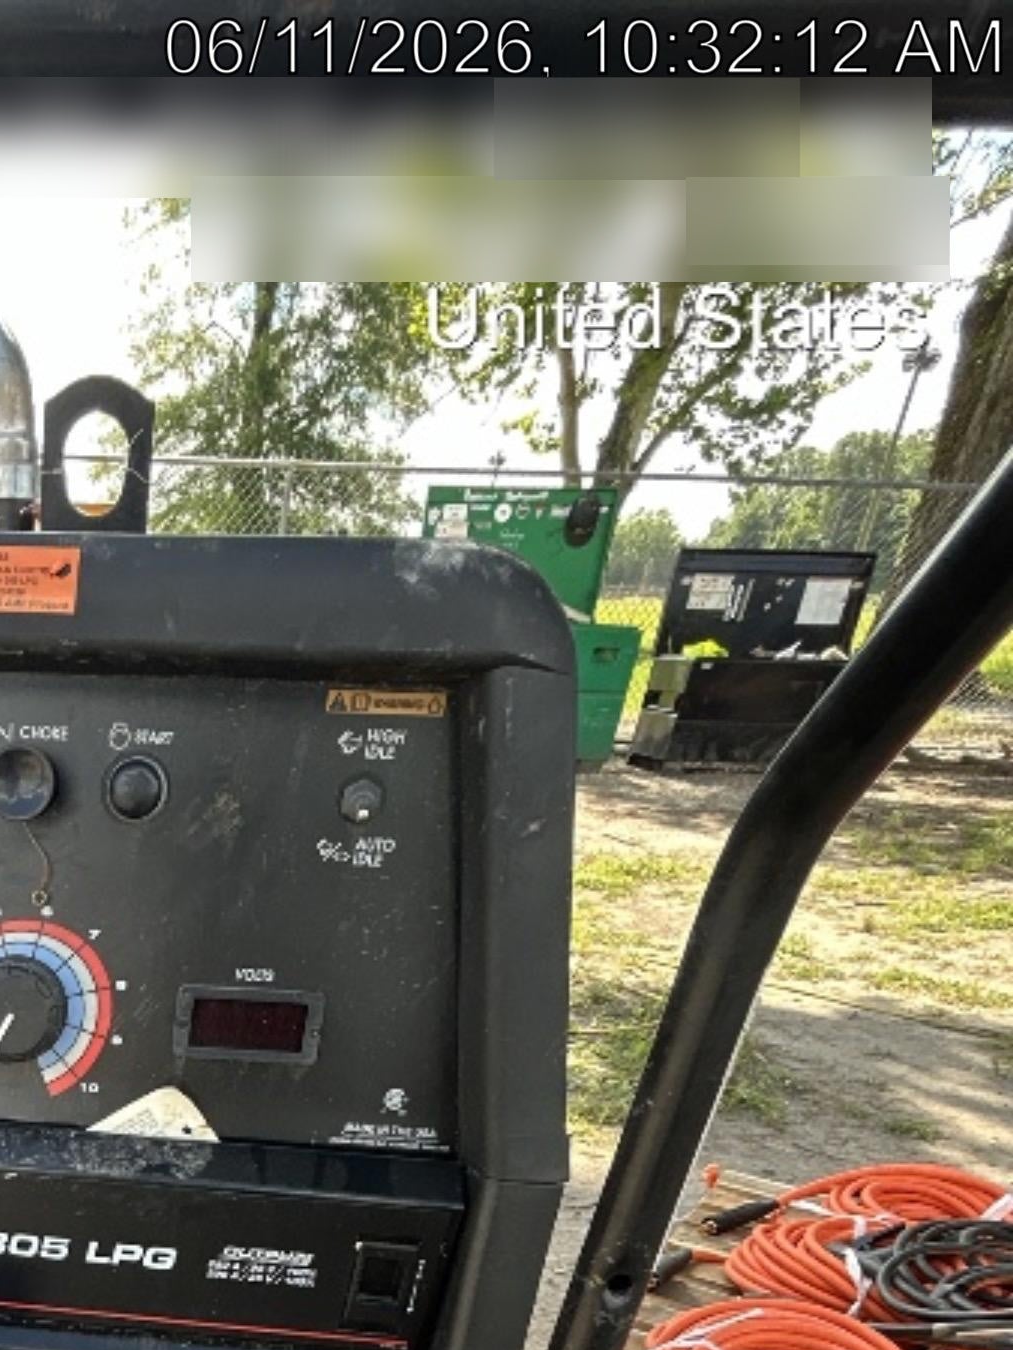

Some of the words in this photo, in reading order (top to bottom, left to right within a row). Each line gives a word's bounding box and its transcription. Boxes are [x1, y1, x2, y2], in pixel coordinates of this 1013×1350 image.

[19, 725, 70, 742] CHOKE
[134, 728, 174, 746] START
[367, 728, 408, 745] HIGH
[364, 745, 396, 760] IDLE
[355, 837, 396, 853] AUTO
[352, 851, 384, 868] IDLE
[88, 929, 102, 941] 7
[80, 1082, 100, 1094] 10
[85, 1239, 178, 1271] LPG
